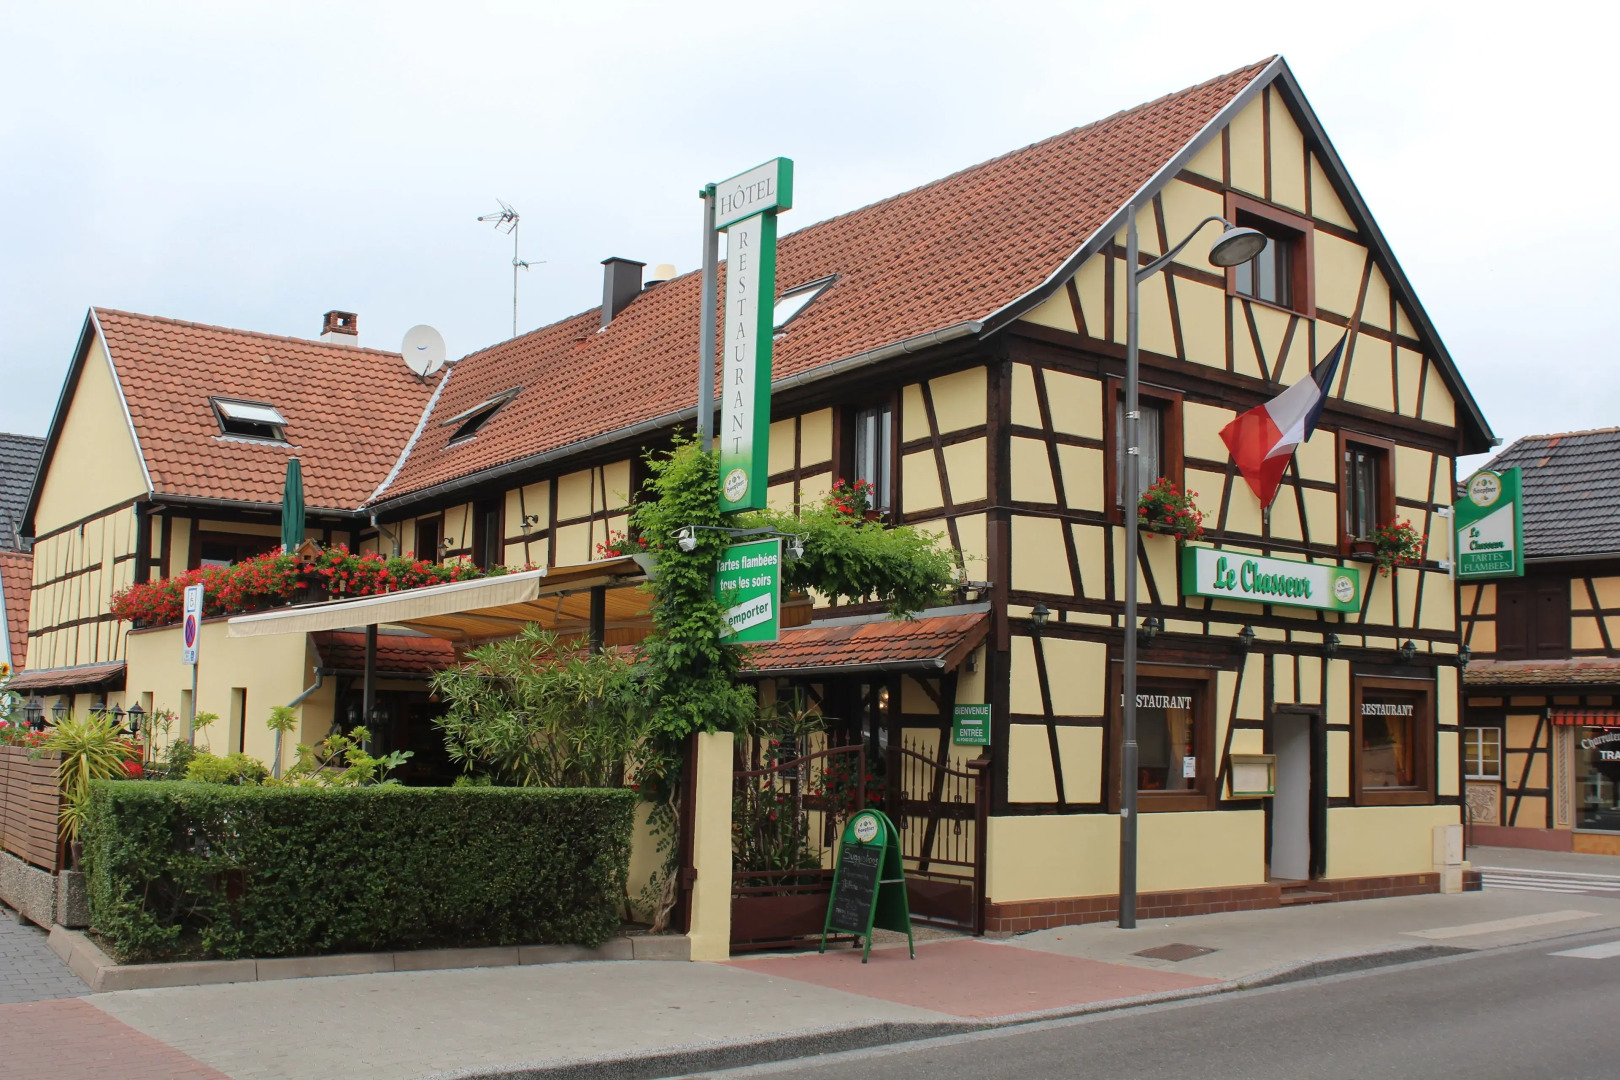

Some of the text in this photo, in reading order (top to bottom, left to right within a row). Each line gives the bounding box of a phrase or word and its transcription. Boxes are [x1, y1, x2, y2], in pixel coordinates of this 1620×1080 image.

[720, 177, 775, 215] HÔTEL
[733, 230, 749, 455] RESTAURANT
[1469, 527, 1480, 538] Le
[716, 553, 777, 572] Tartes flambées
[1470, 552, 1504, 562] TARTES
[720, 573, 771, 591] tous les soirs
[1213, 556, 1313, 600] Le Chasseur
[728, 602, 769, 626] emporter
[954, 706, 989, 715] BIENVENUE
[1120, 694, 1192, 710] STAURANT
[1361, 703, 1414, 717] RESTAURANT
[959, 727, 983, 737] ENTRÉE
